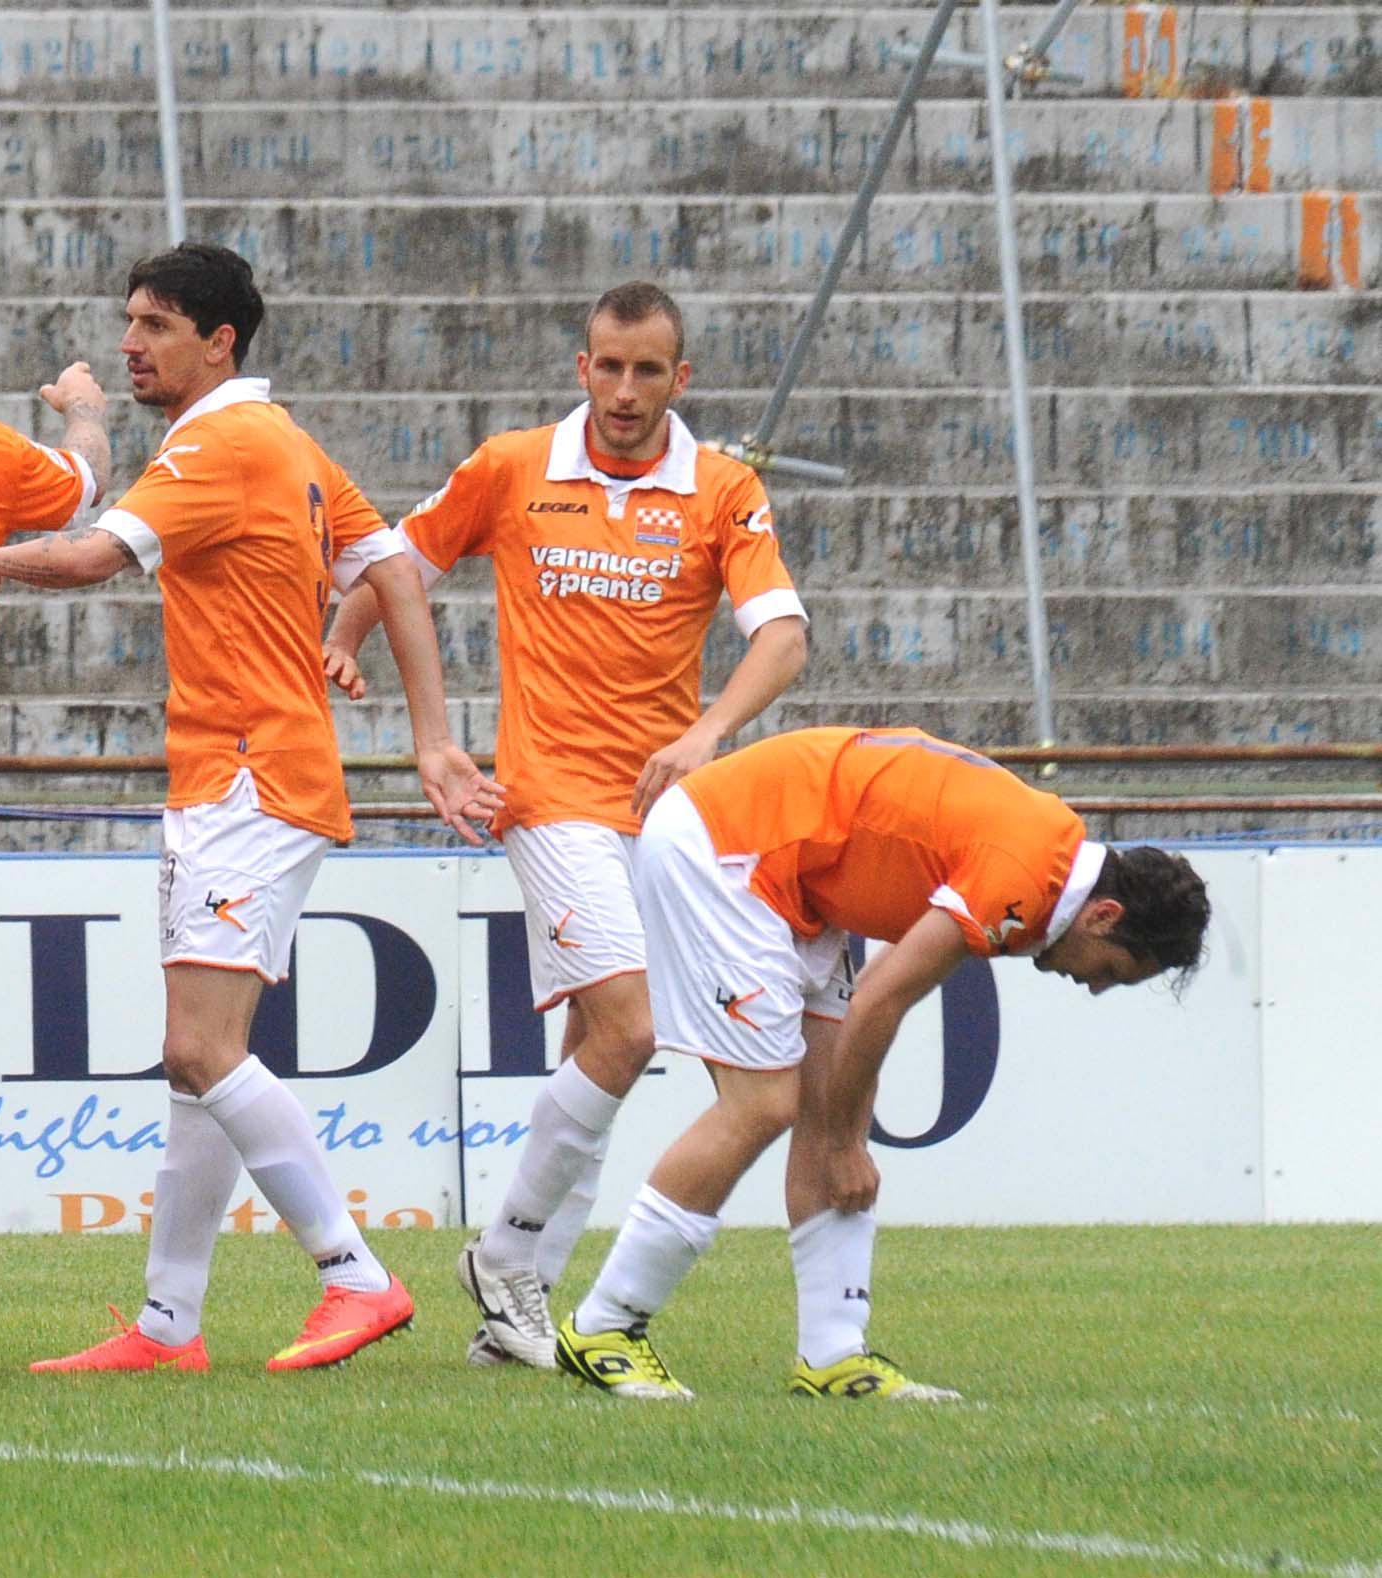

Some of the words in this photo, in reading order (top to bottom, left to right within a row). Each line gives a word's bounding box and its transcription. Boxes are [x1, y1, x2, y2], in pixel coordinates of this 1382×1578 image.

[527, 501, 589, 514] LEGEA
[530, 545, 683, 579] vannucci
[557, 569, 664, 603] piante
